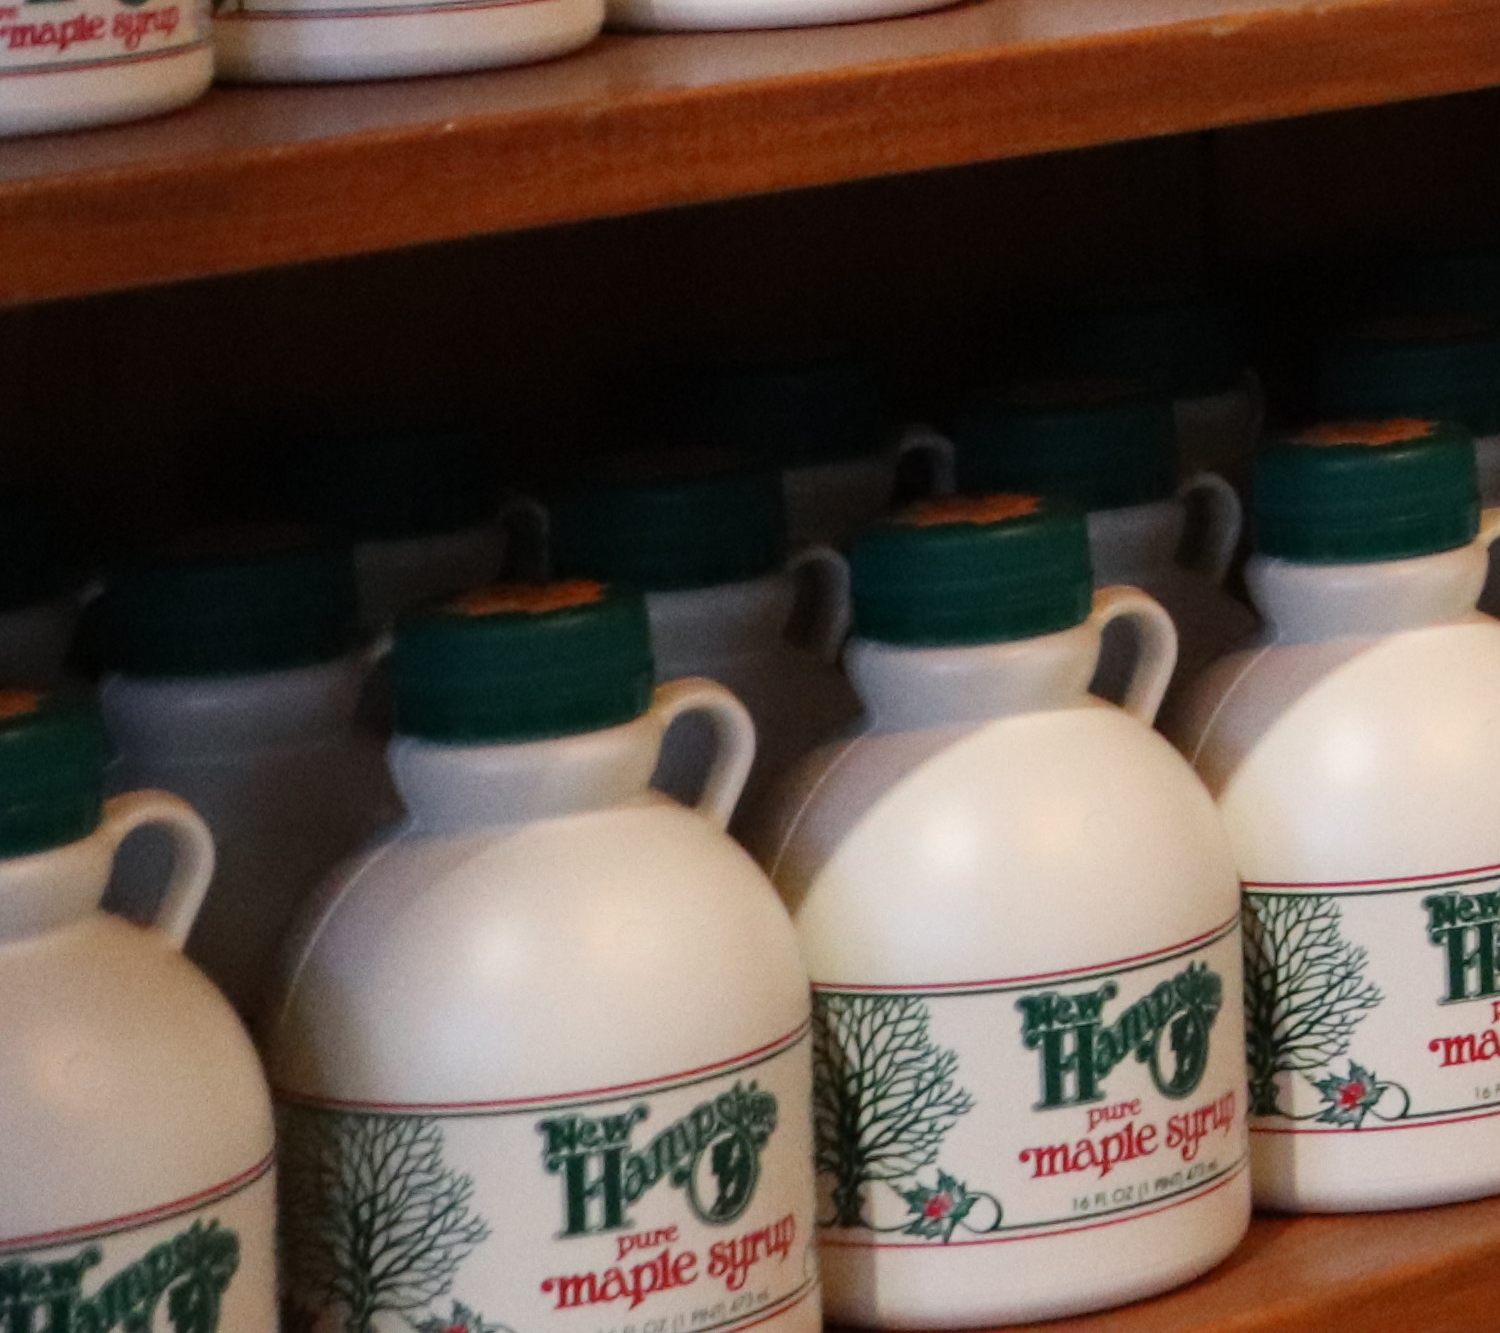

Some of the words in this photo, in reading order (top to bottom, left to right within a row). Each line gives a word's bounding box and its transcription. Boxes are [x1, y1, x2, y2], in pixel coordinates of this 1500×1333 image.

[0, 13, 105, 52] maple
[1014, 979, 1119, 1030] New
[536, 1101, 650, 1151] New
[1018, 1124, 1159, 1179] maple
[1166, 1090, 1236, 1161] syrup
[1087, 1098, 1142, 1132] pure
[1112, 1186, 1134, 1204] OZ
[541, 1249, 698, 1310] maple
[707, 1212, 796, 1291] syrup
[616, 1224, 678, 1261] pure
